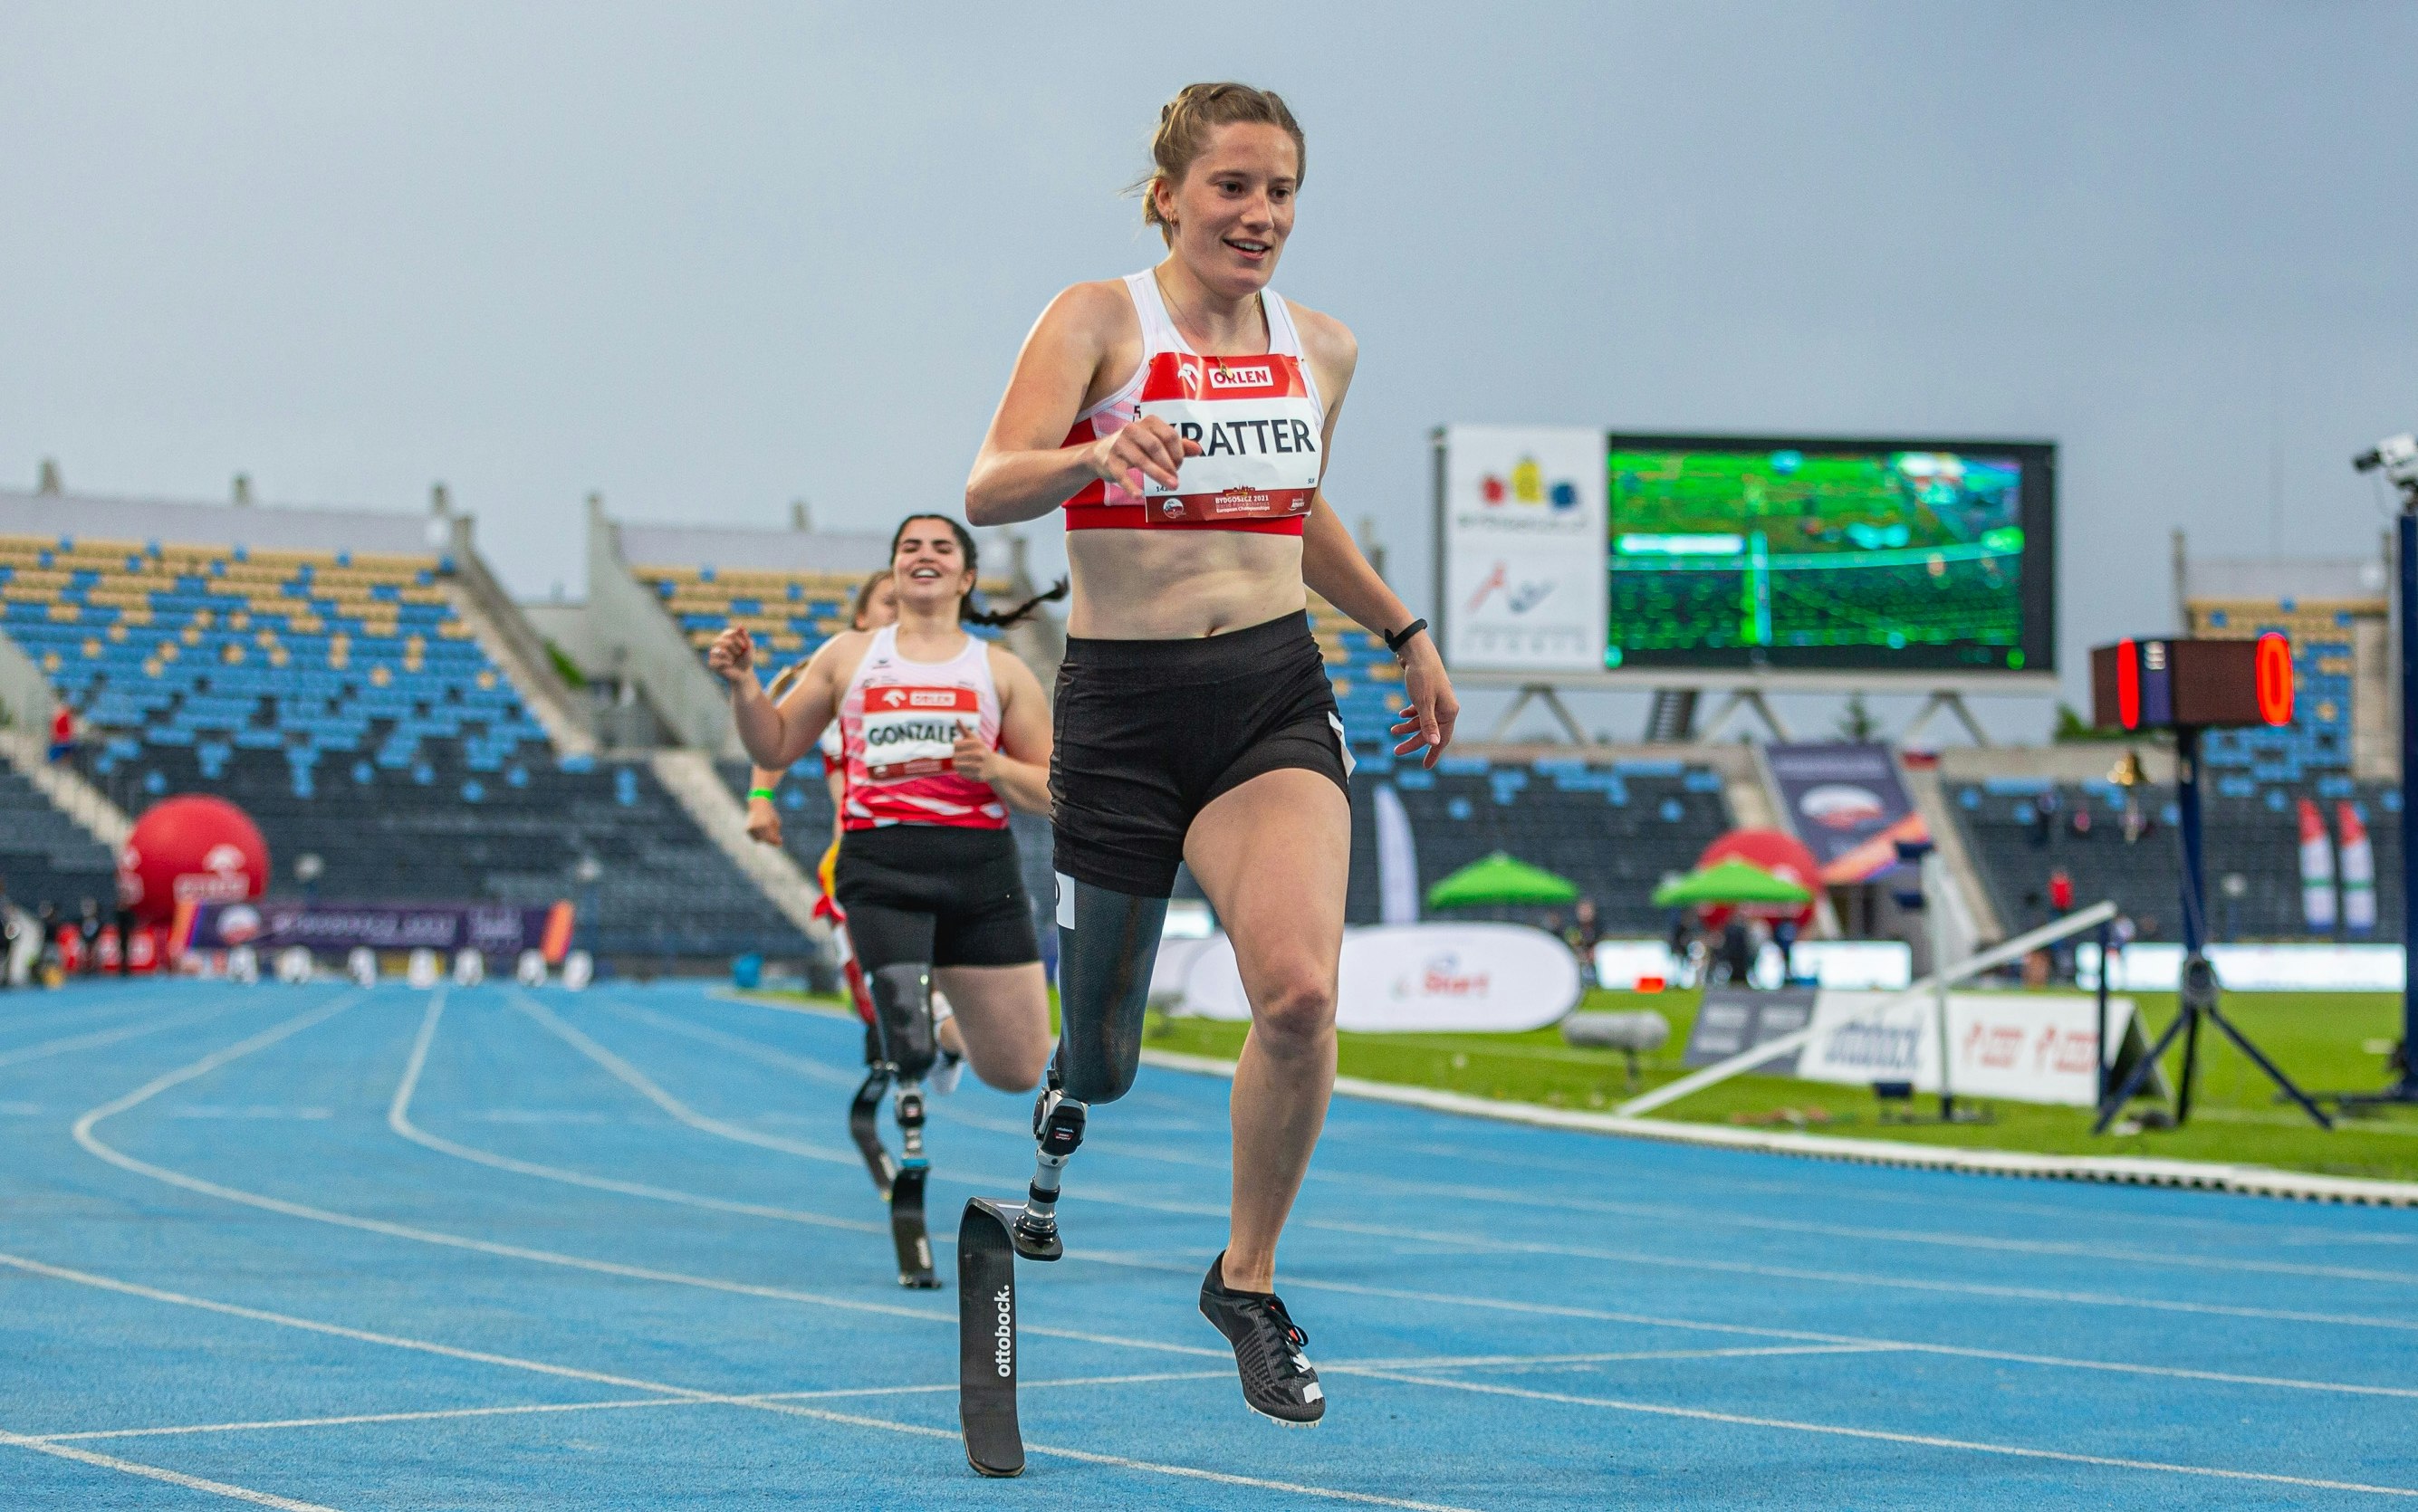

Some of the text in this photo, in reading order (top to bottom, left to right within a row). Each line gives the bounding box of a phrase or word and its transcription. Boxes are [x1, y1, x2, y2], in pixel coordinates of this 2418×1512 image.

[1169, 419, 1316, 457] RATTER
[868, 723, 973, 746] GONZALE
[993, 1285, 1012, 1378] ottobock.
